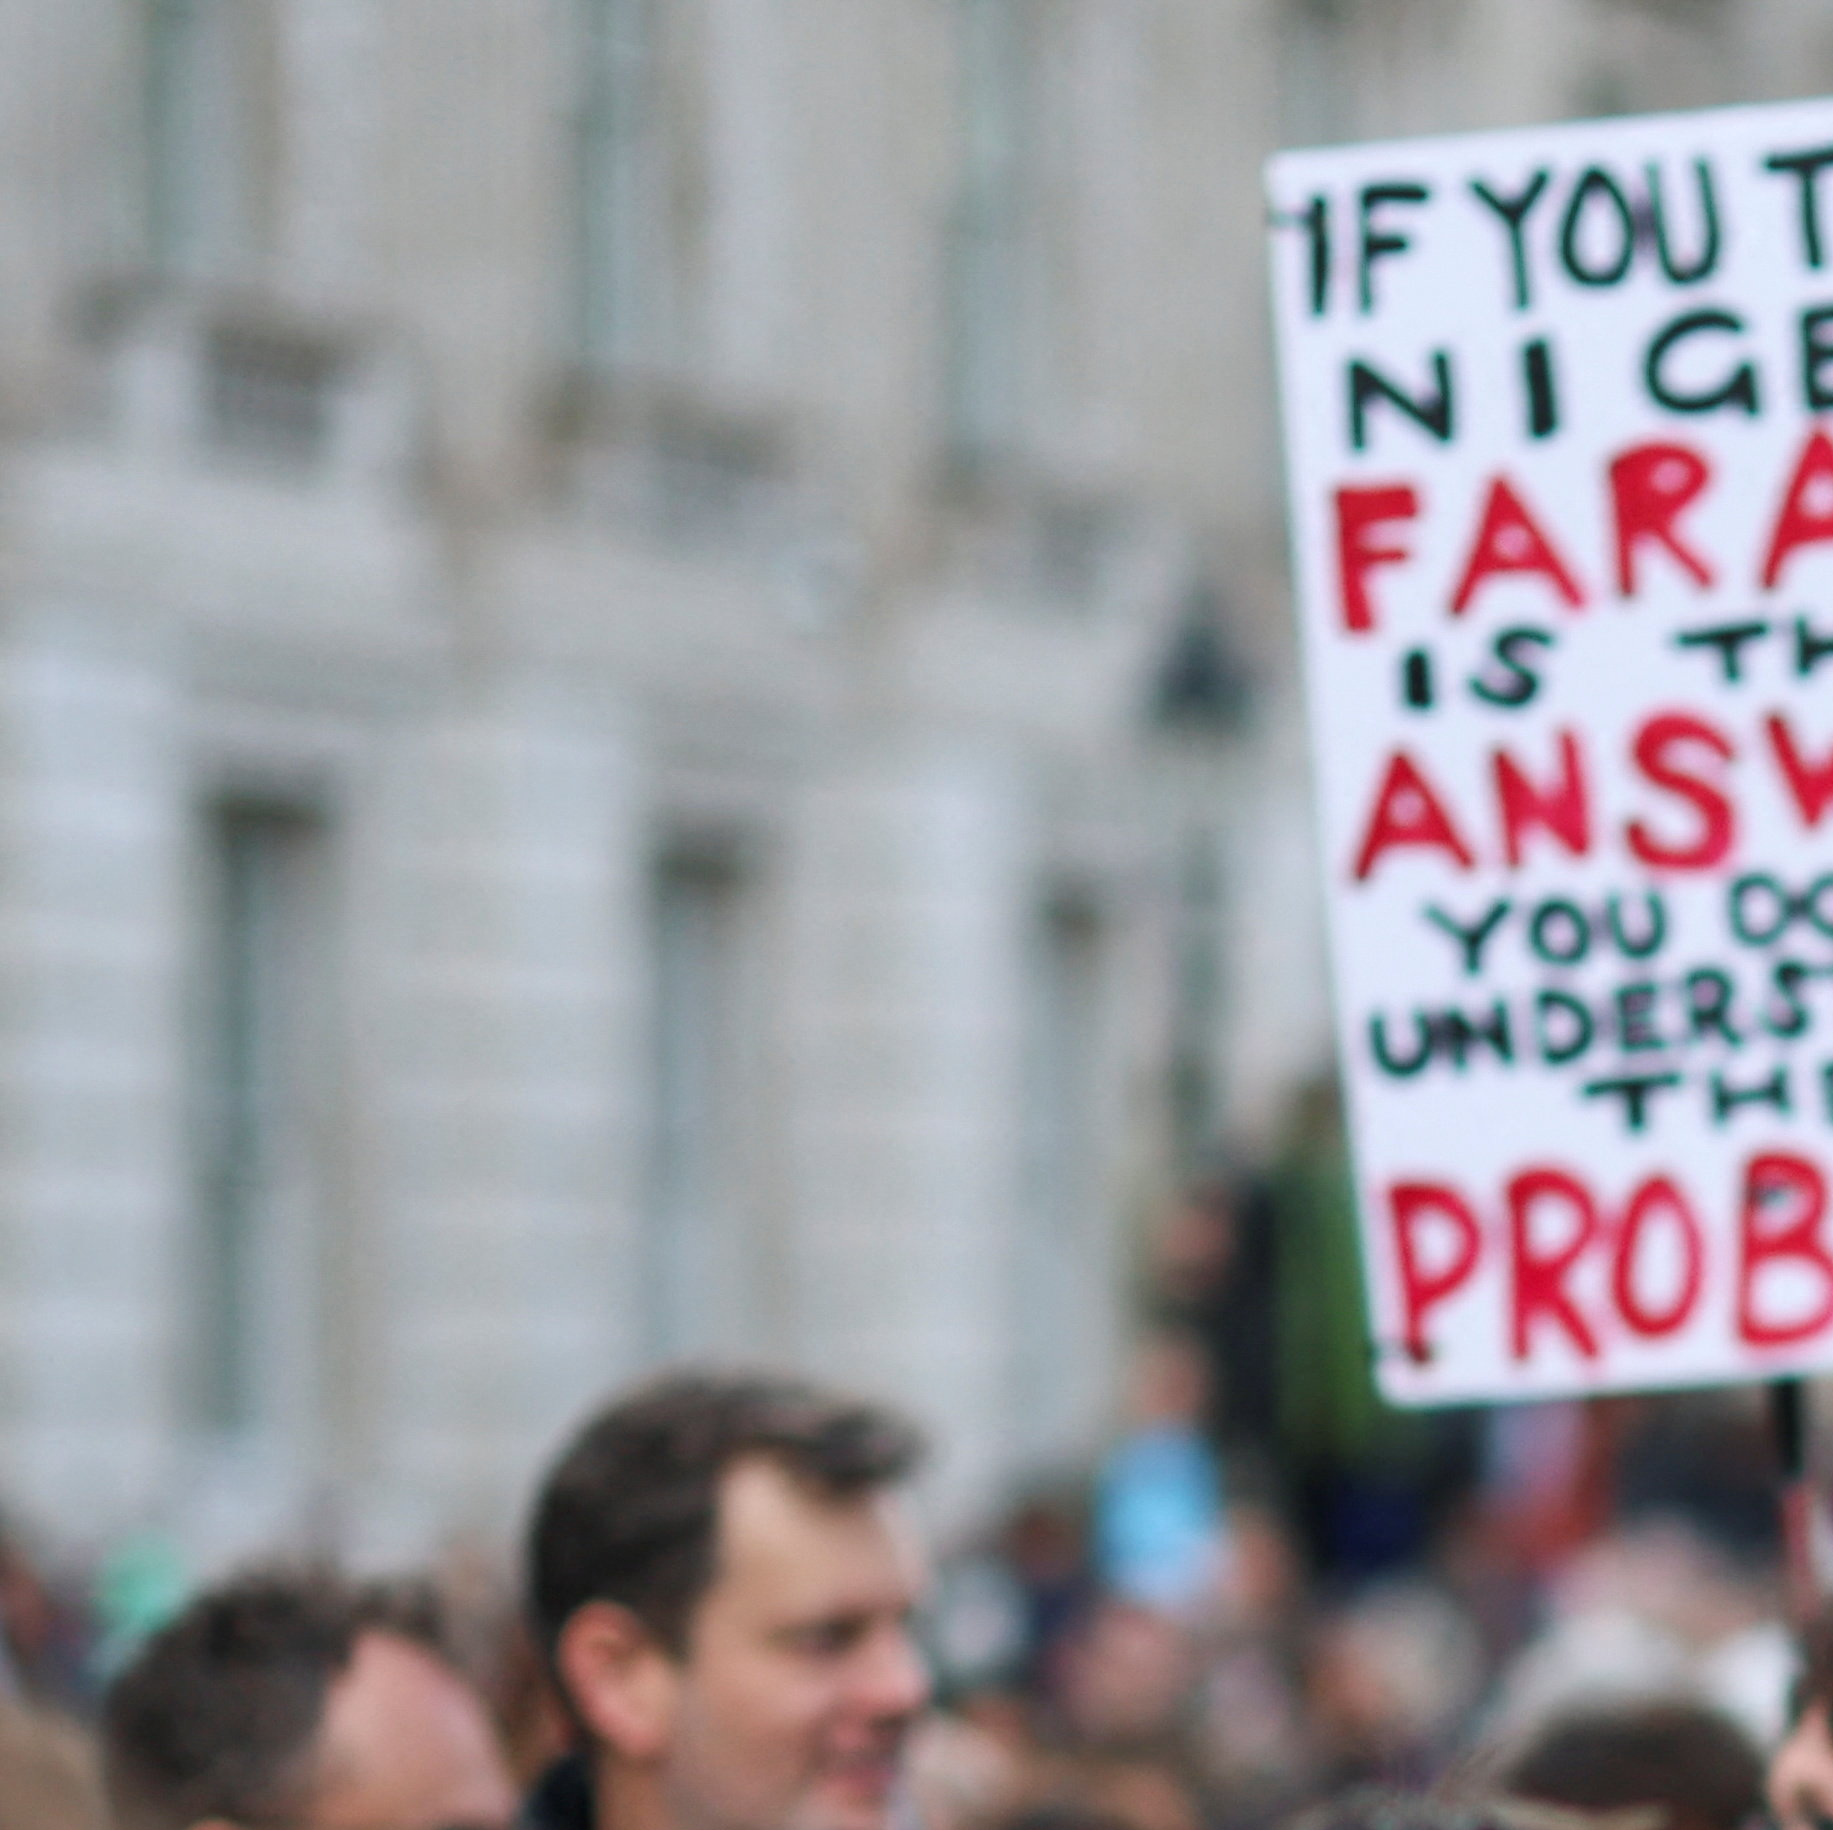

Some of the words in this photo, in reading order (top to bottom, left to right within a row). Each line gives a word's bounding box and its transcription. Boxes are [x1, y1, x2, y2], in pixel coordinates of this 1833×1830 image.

[1297, 182, 1430, 319] IF
[1471, 158, 1724, 312] YOU
[1400, 625, 1553, 713] IS
[1425, 893, 1668, 976] YOU
